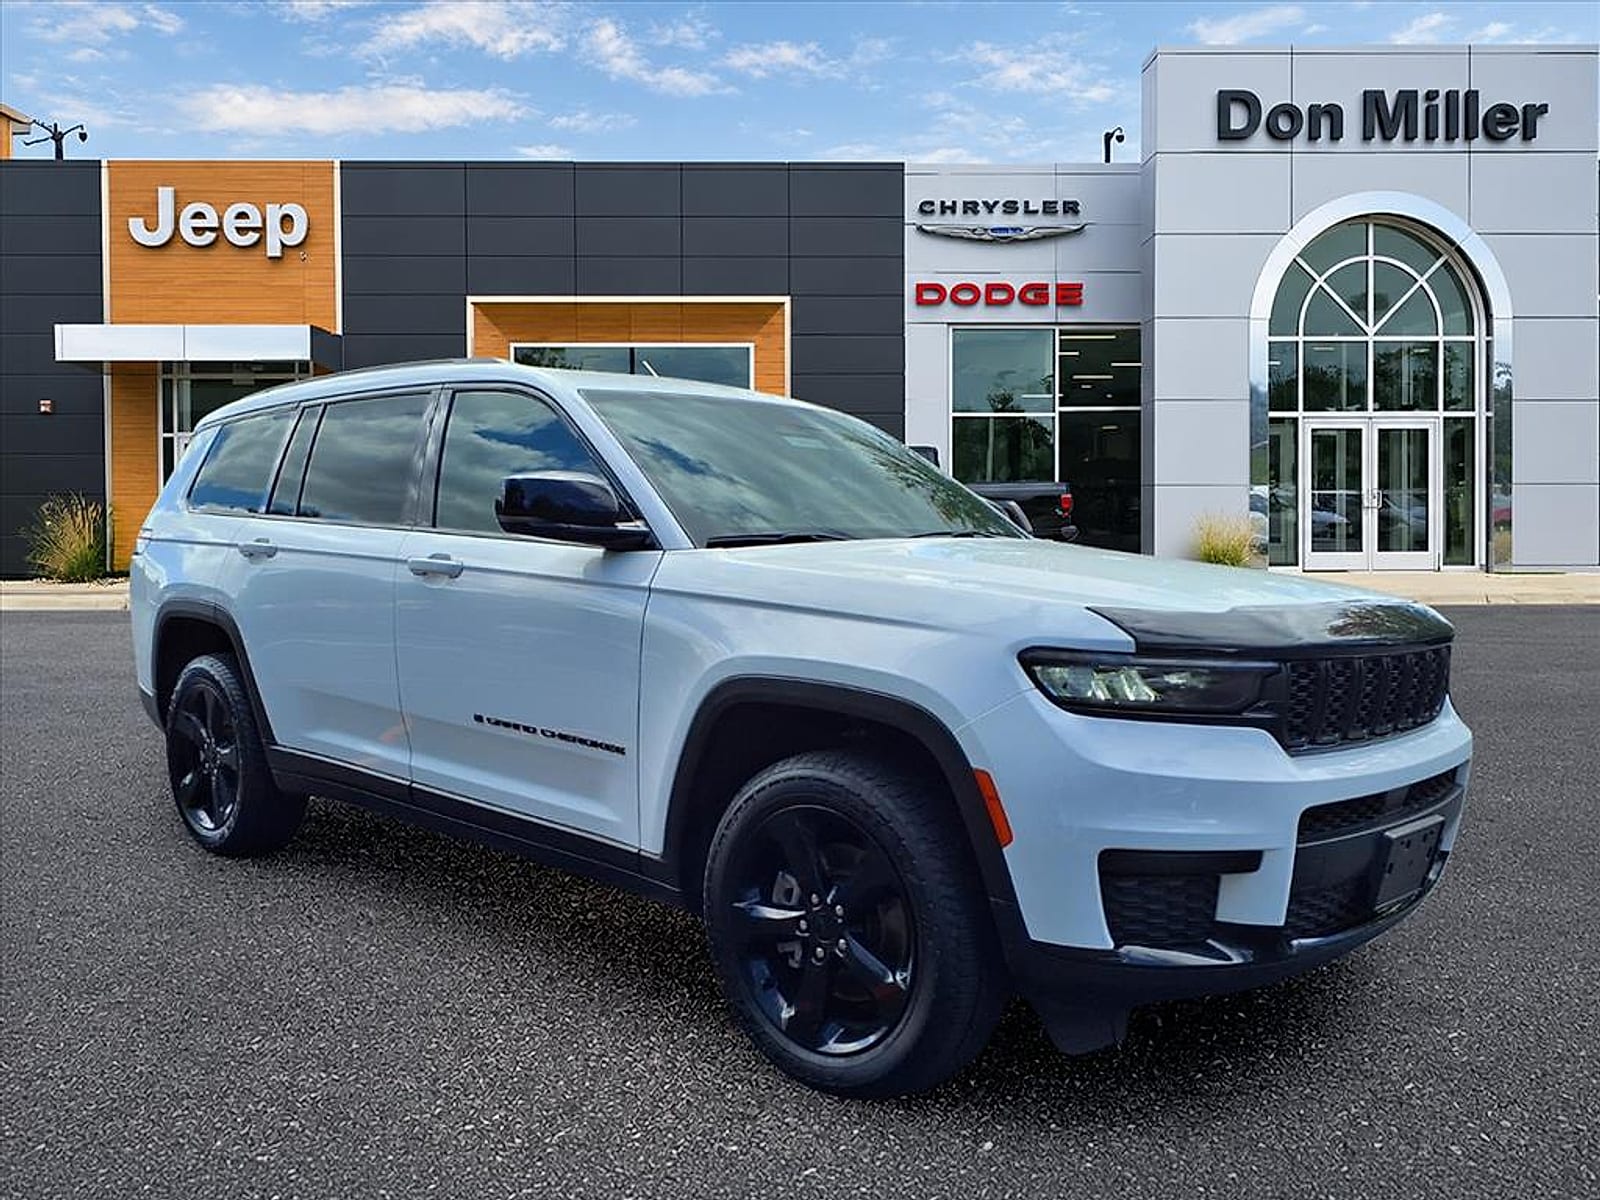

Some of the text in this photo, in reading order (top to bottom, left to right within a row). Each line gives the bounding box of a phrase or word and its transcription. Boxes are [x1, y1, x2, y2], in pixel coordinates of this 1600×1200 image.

[1216, 89, 1549, 144] Don Miller
[918, 200, 1081, 216] CHRYSLER
[127, 186, 309, 259] Jeep
[915, 282, 1084, 307] DODGE
[540, 729, 626, 756] CHEROKEE
